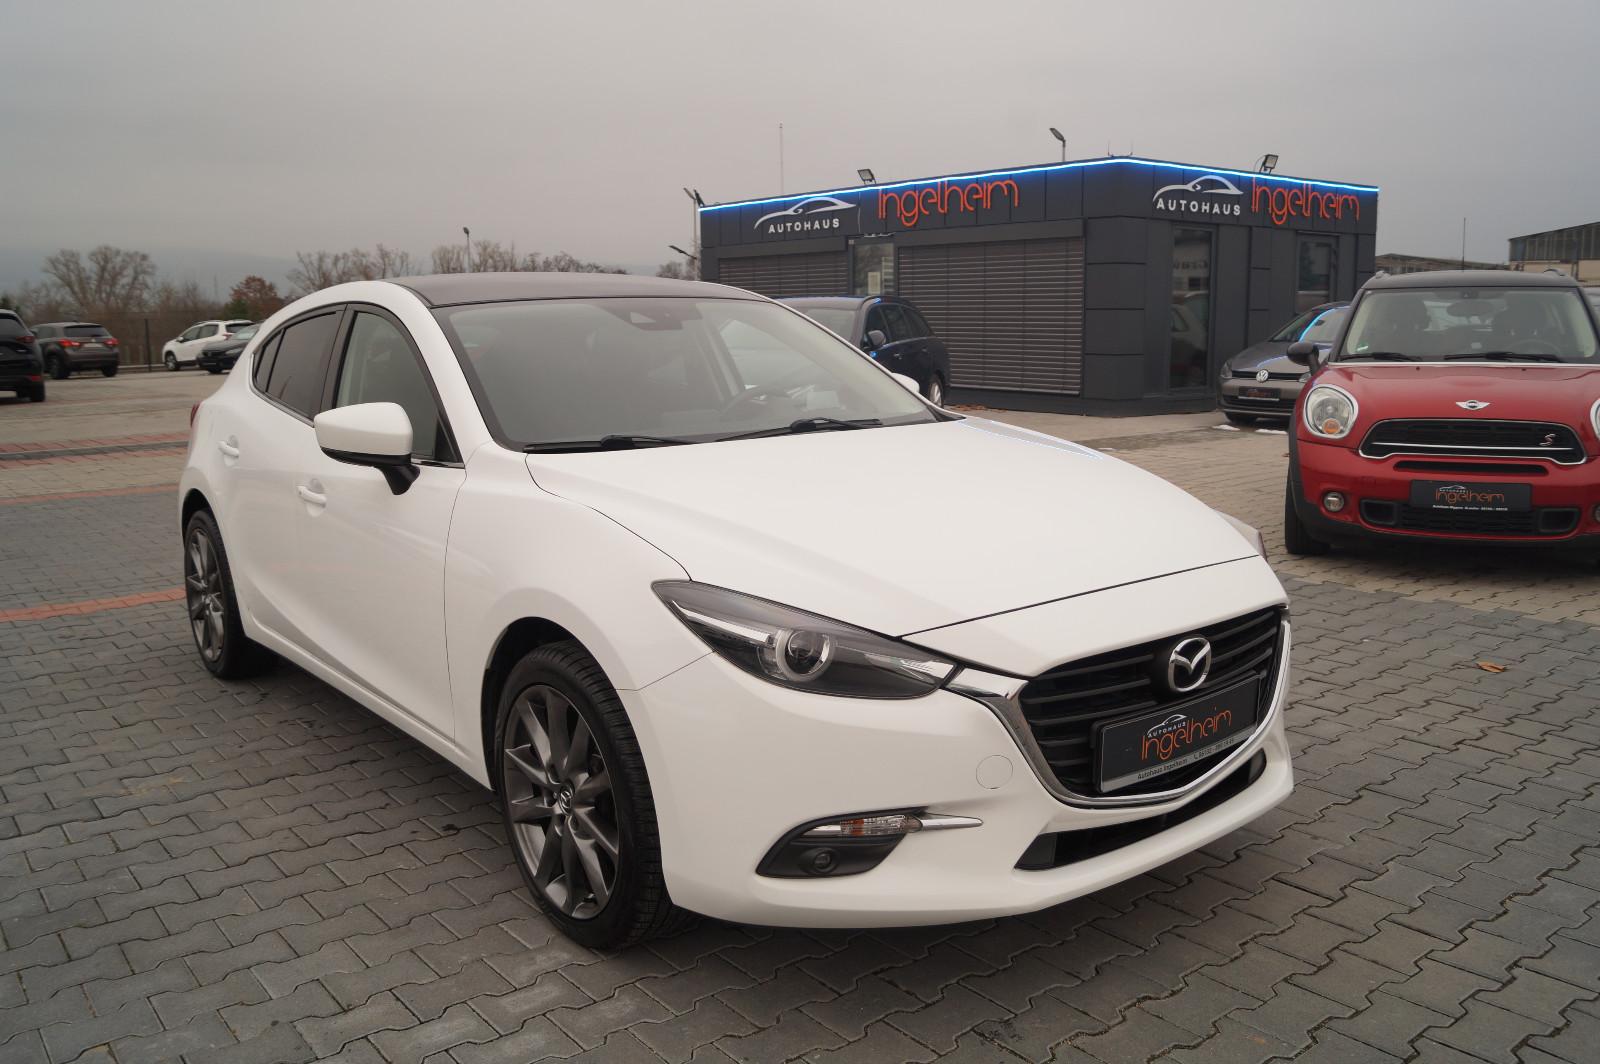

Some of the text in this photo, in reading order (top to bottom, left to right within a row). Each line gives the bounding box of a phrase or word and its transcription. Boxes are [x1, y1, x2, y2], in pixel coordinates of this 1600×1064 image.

[767, 179, 1019, 234] AUTOHAUS Ingelheim
[1156, 176, 1360, 225] AUTOHAUS Ingelheim
[1141, 707, 1232, 760] Ingelheim
[1148, 721, 1187, 738] AUTOHAUS
